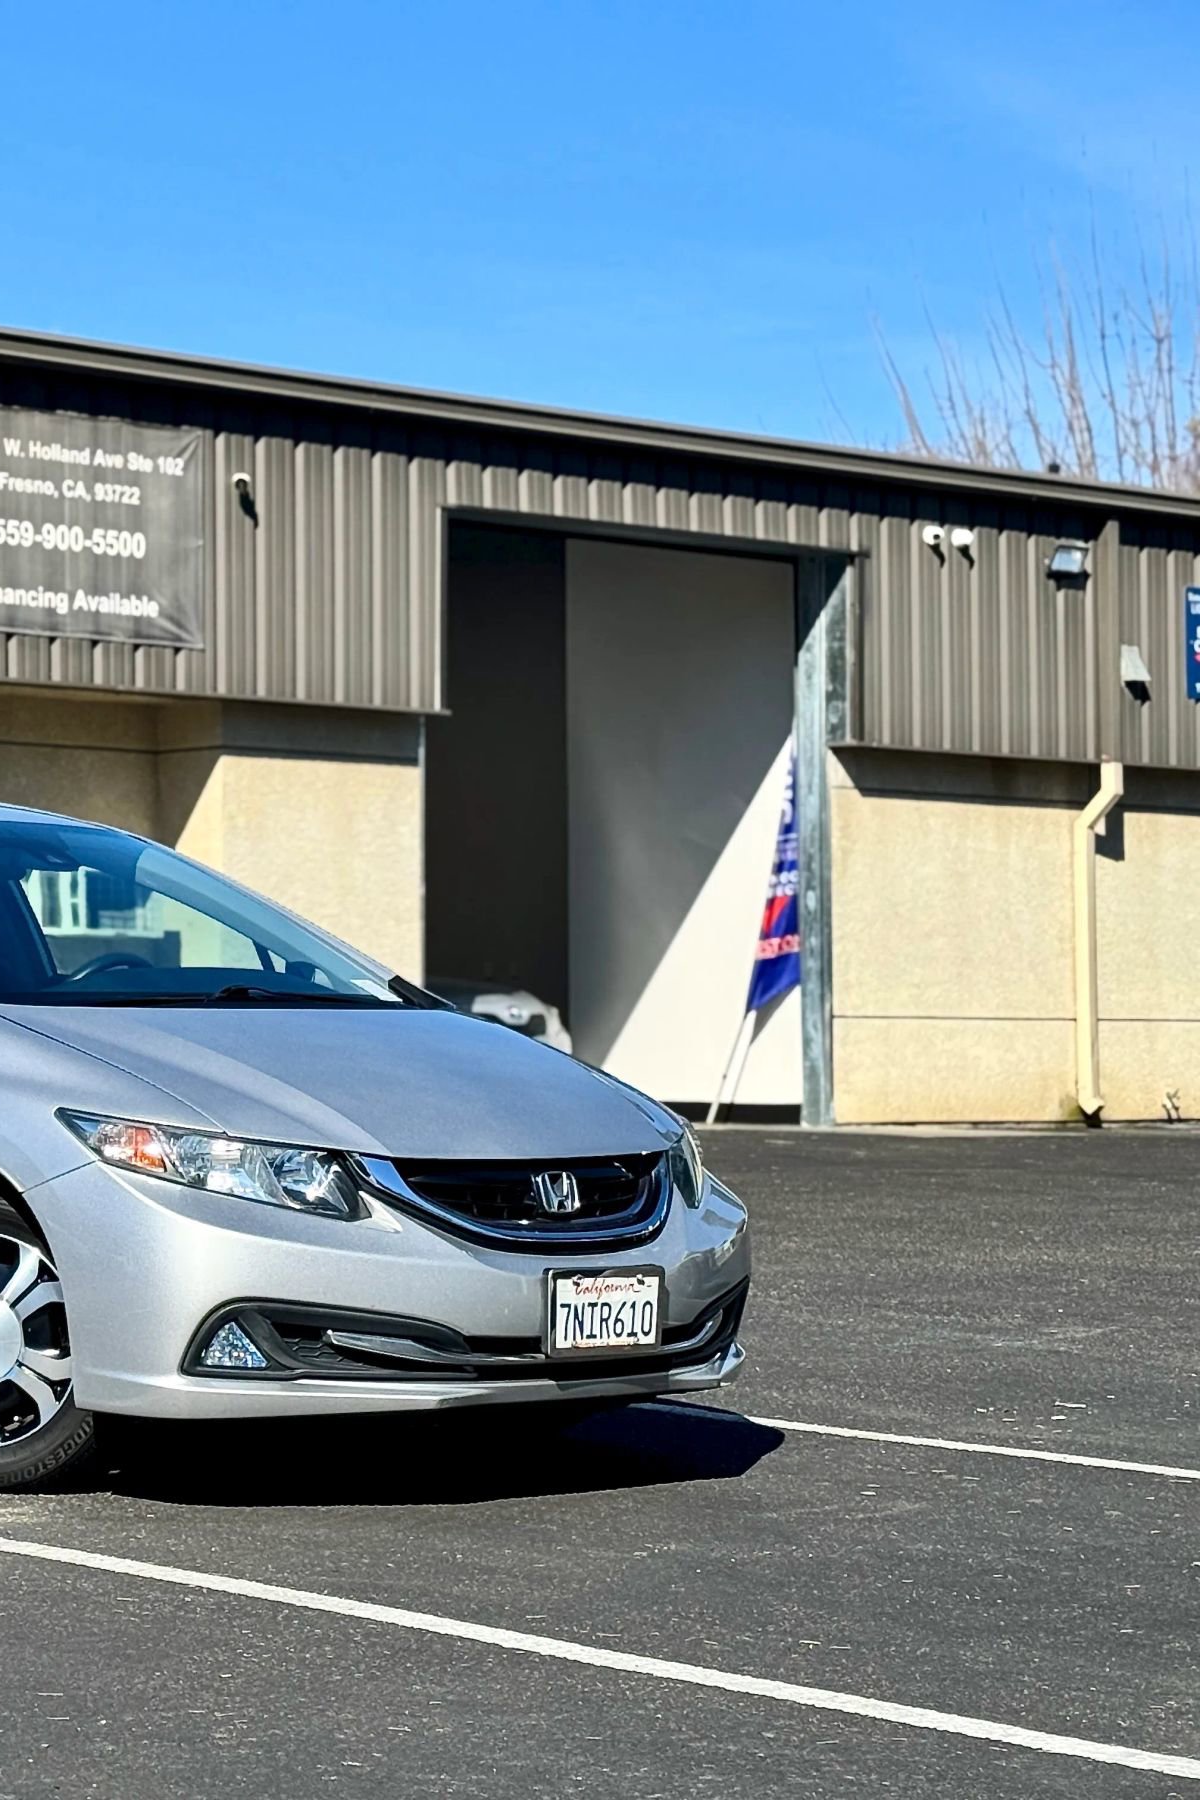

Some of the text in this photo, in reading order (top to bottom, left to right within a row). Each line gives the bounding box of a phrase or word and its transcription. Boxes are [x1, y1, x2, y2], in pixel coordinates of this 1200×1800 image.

[3, 437, 26, 458] W.
[28, 440, 91, 466] Holland
[93, 448, 124, 469] Ave
[126, 452, 154, 473] Ste
[157, 456, 185, 477] 102
[62, 479, 92, 502] CA,
[94, 483, 141, 506] 93722
[72, 588, 160, 618] Available
[573, 1277, 642, 1300] California
[559, 1300, 654, 1342] 7NIR610
